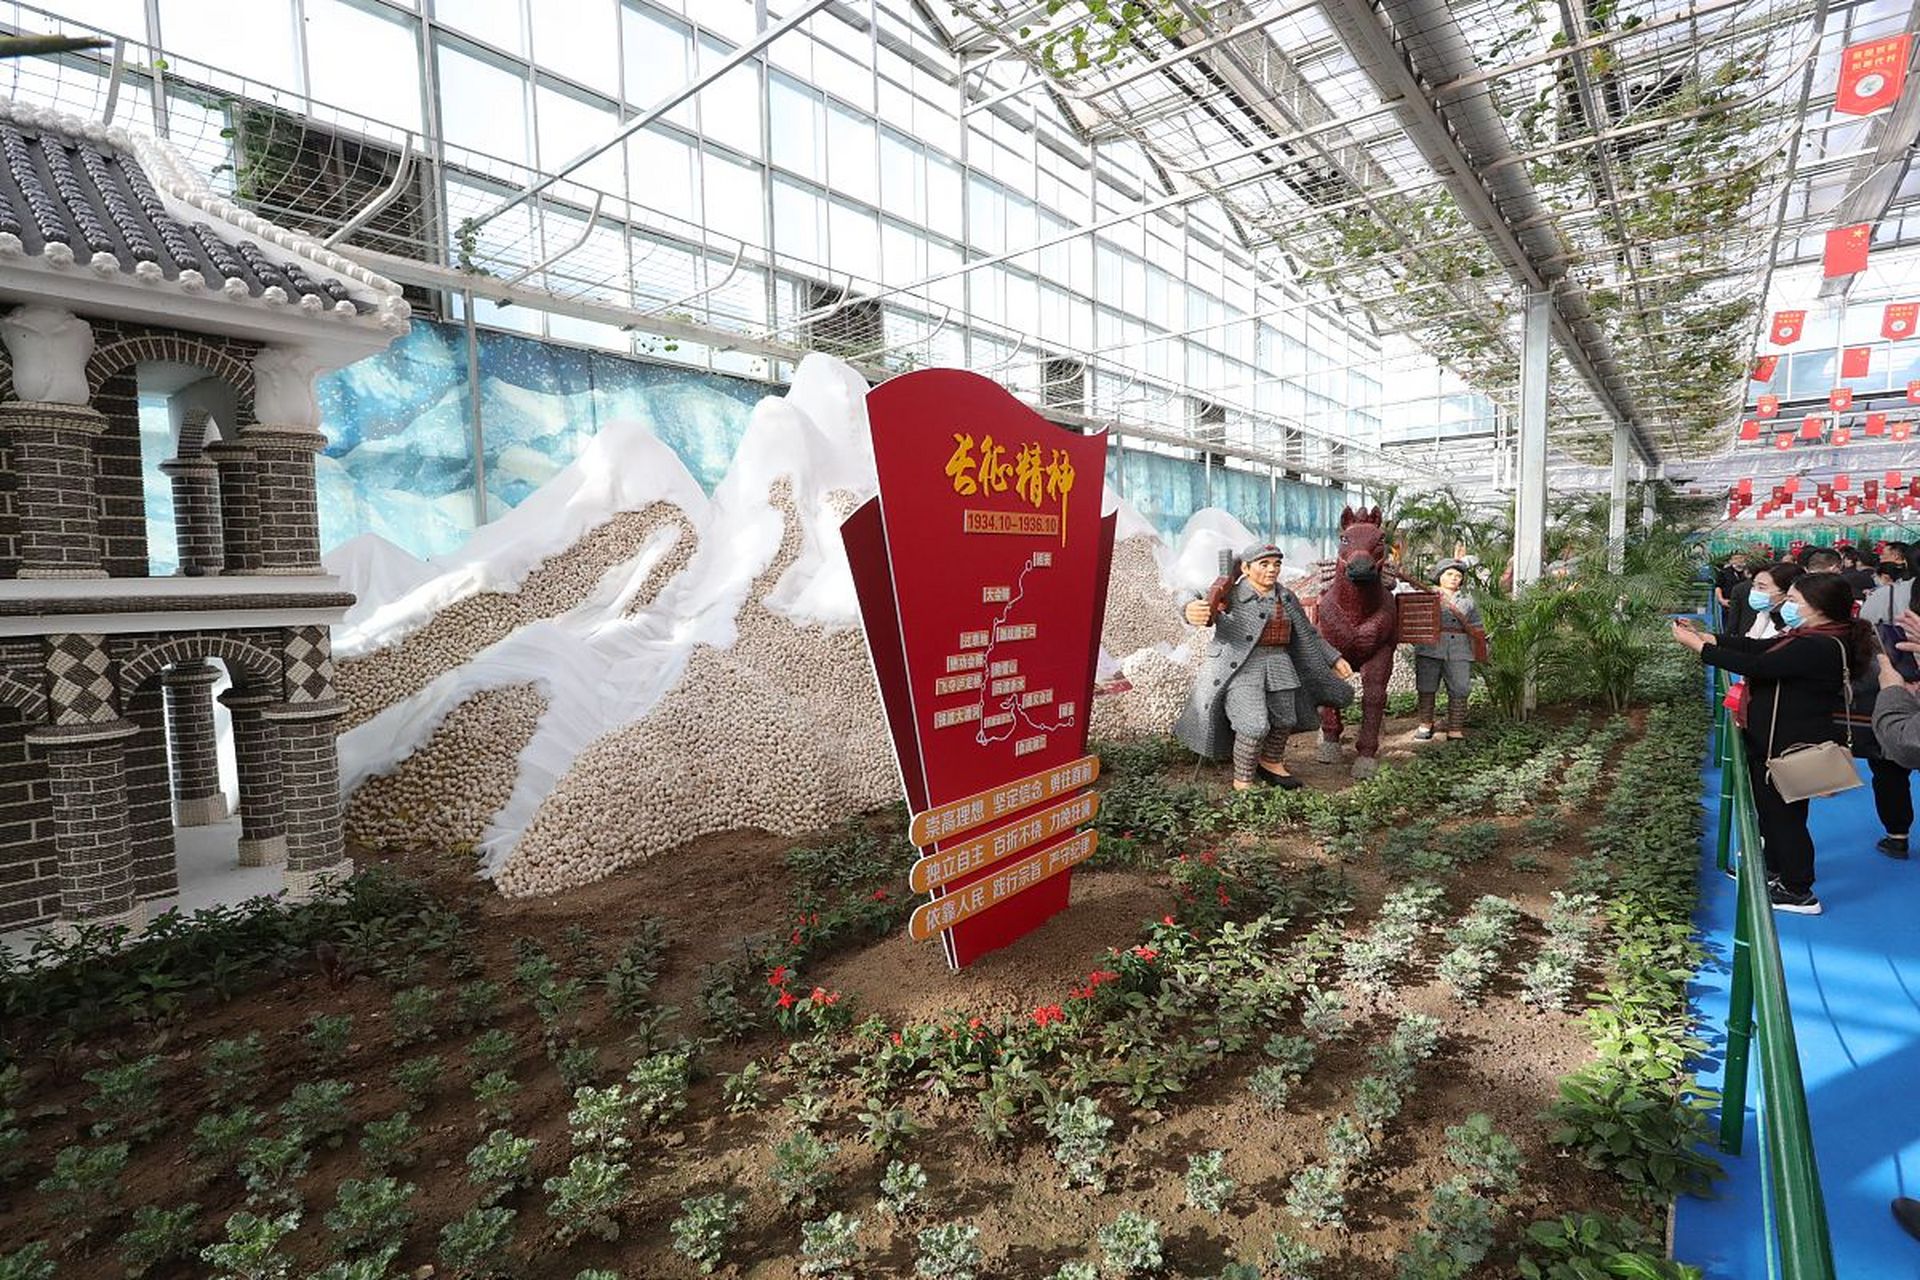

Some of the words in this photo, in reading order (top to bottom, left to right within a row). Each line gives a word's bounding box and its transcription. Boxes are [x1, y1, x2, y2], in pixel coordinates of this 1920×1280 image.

[945, 432, 1076, 548] 长征精神
[925, 799, 985, 840] 崇高理想
[992, 780, 1043, 814] 坚定信念
[1050, 763, 1092, 791] 勇往直前
[926, 844, 985, 886] 独立自主
[993, 821, 1043, 856] 百折不挠
[926, 887, 985, 933] 依靠人民
[993, 860, 1042, 898] 践行宗旨
[1048, 837, 1091, 872] 严守纪律
